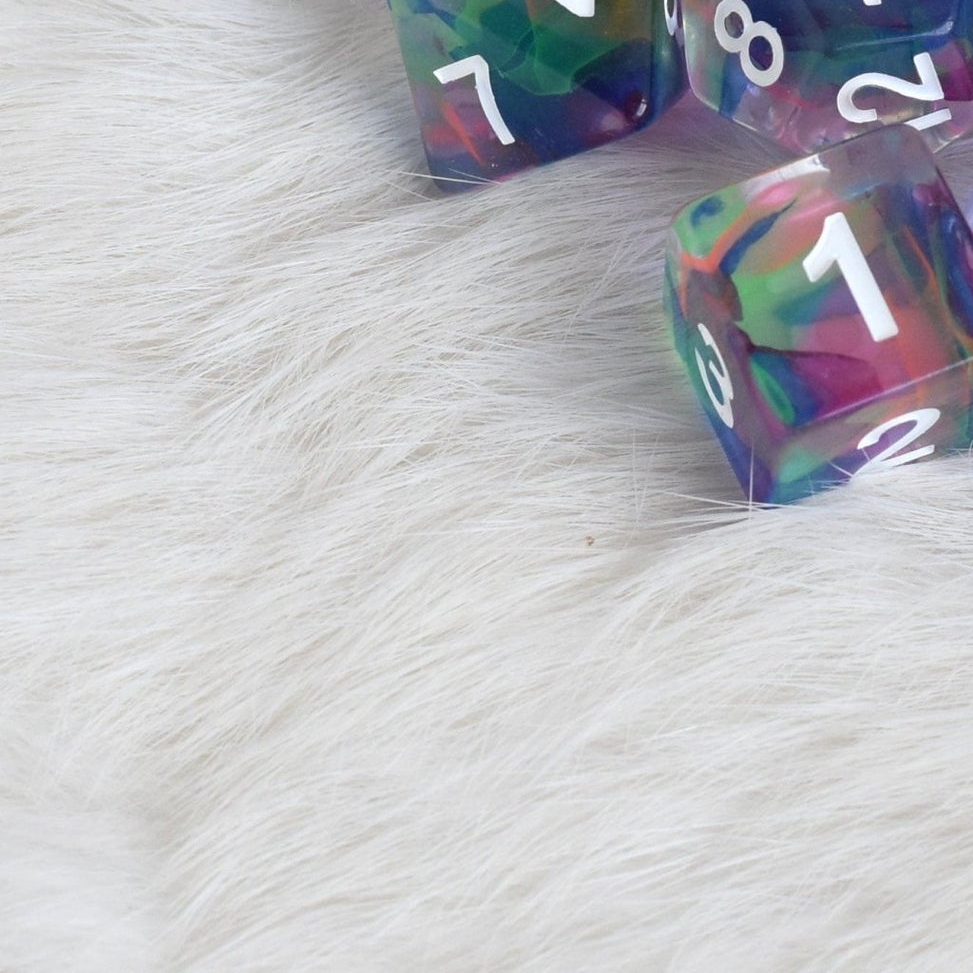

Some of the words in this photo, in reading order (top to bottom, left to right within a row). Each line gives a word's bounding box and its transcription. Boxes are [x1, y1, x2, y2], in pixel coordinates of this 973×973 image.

[433, 54, 515, 146] 7
[802, 212, 899, 342] 1
[855, 408, 941, 476] 2
